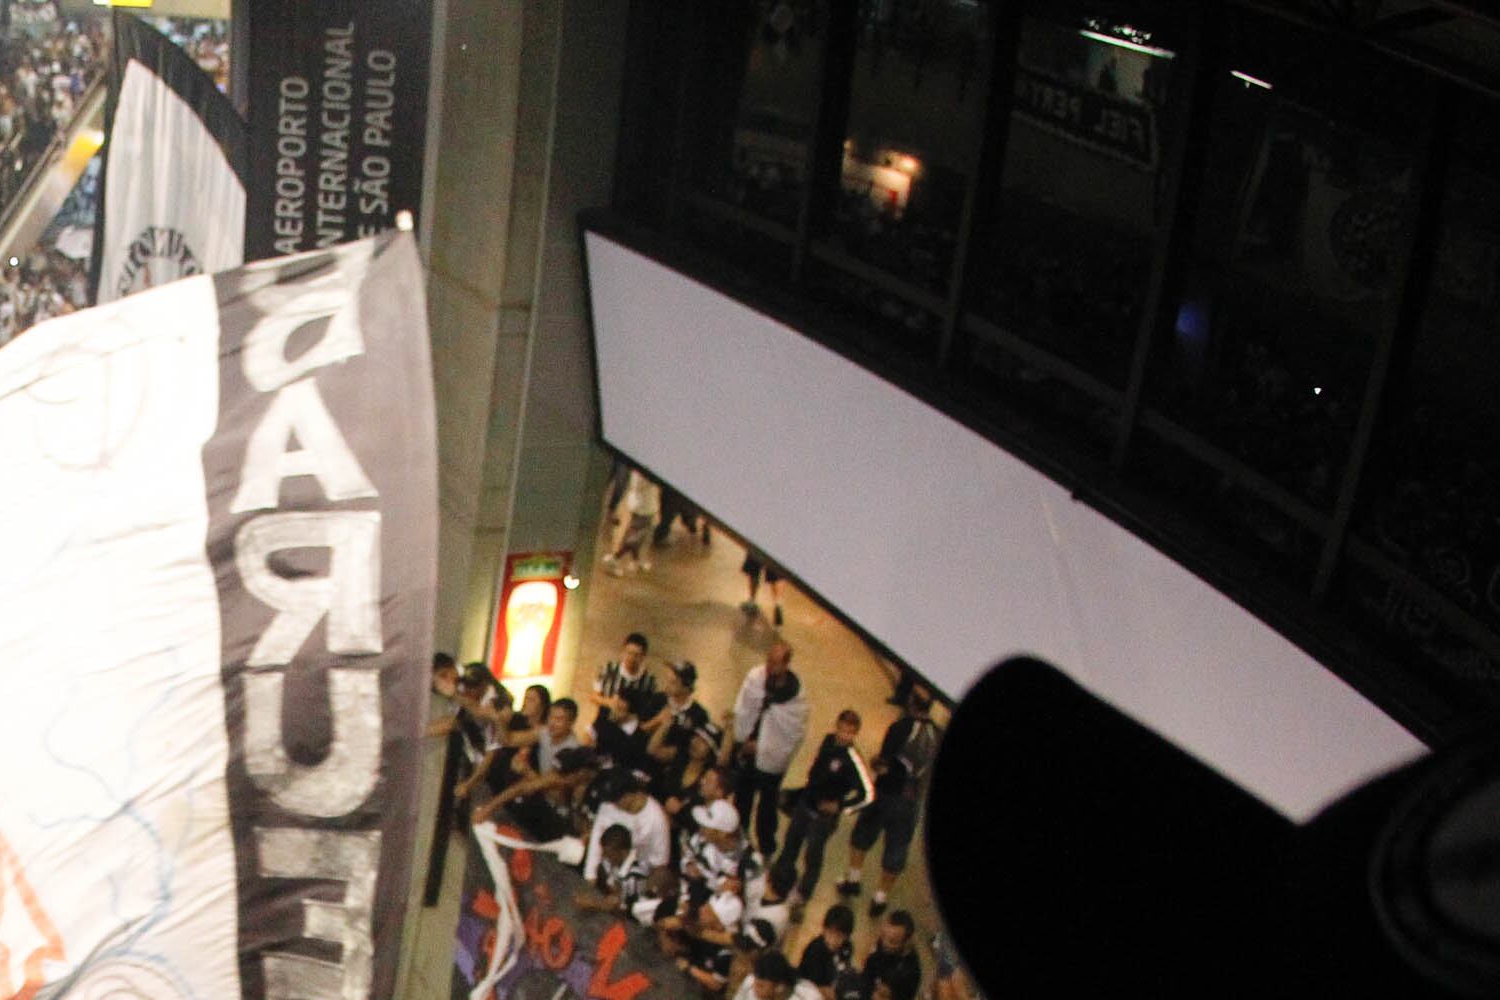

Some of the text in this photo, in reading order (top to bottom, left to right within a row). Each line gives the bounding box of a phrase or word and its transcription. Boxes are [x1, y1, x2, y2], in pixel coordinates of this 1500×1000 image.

[274, 76, 310, 254] AEROPORTO
[316, 21, 355, 248] NTERNACIONAL
[363, 51, 397, 148] PAULO
[353, 154, 391, 215] SÃO
